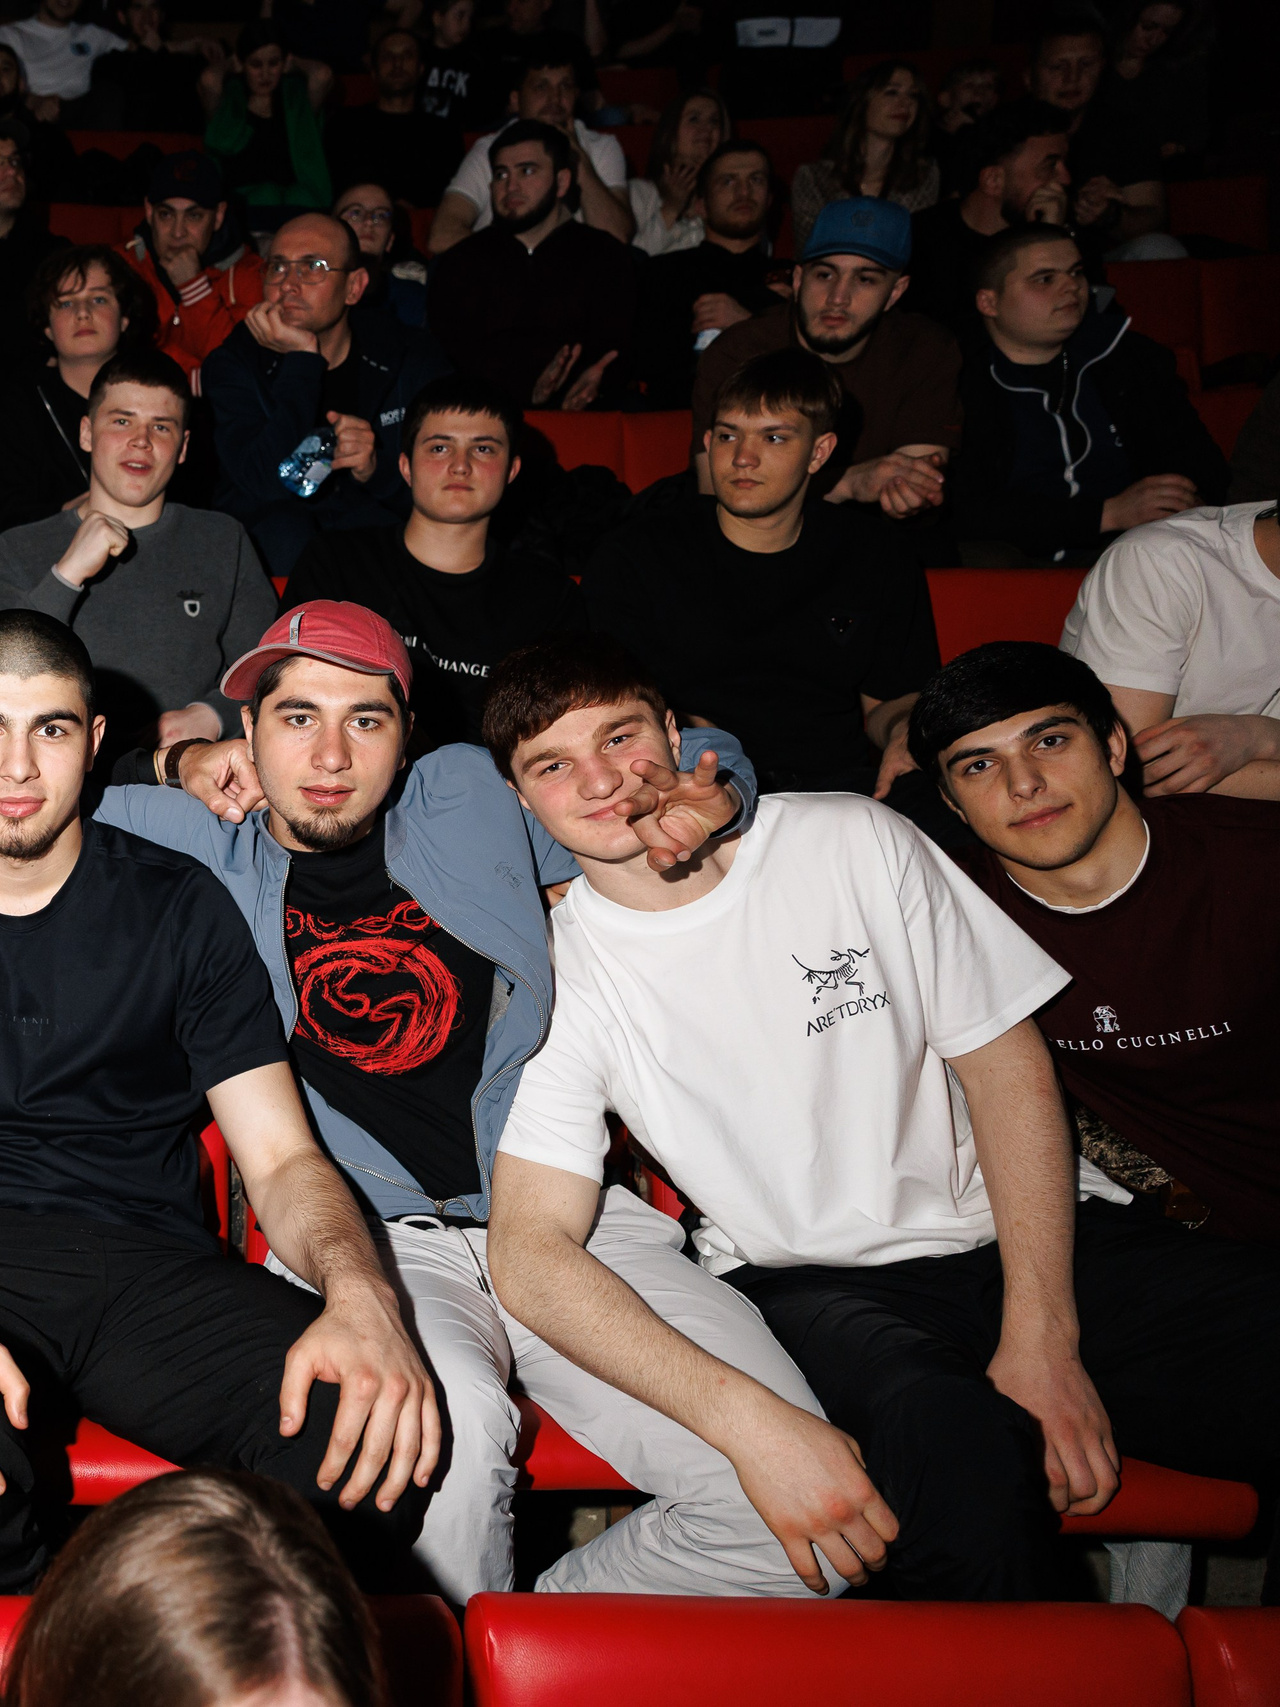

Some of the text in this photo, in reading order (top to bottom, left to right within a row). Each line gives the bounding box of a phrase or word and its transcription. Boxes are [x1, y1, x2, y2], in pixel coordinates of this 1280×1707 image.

[423, 642, 491, 678] CHANGE
[1052, 1021, 1232, 1051] ELLO CUCINELLI
